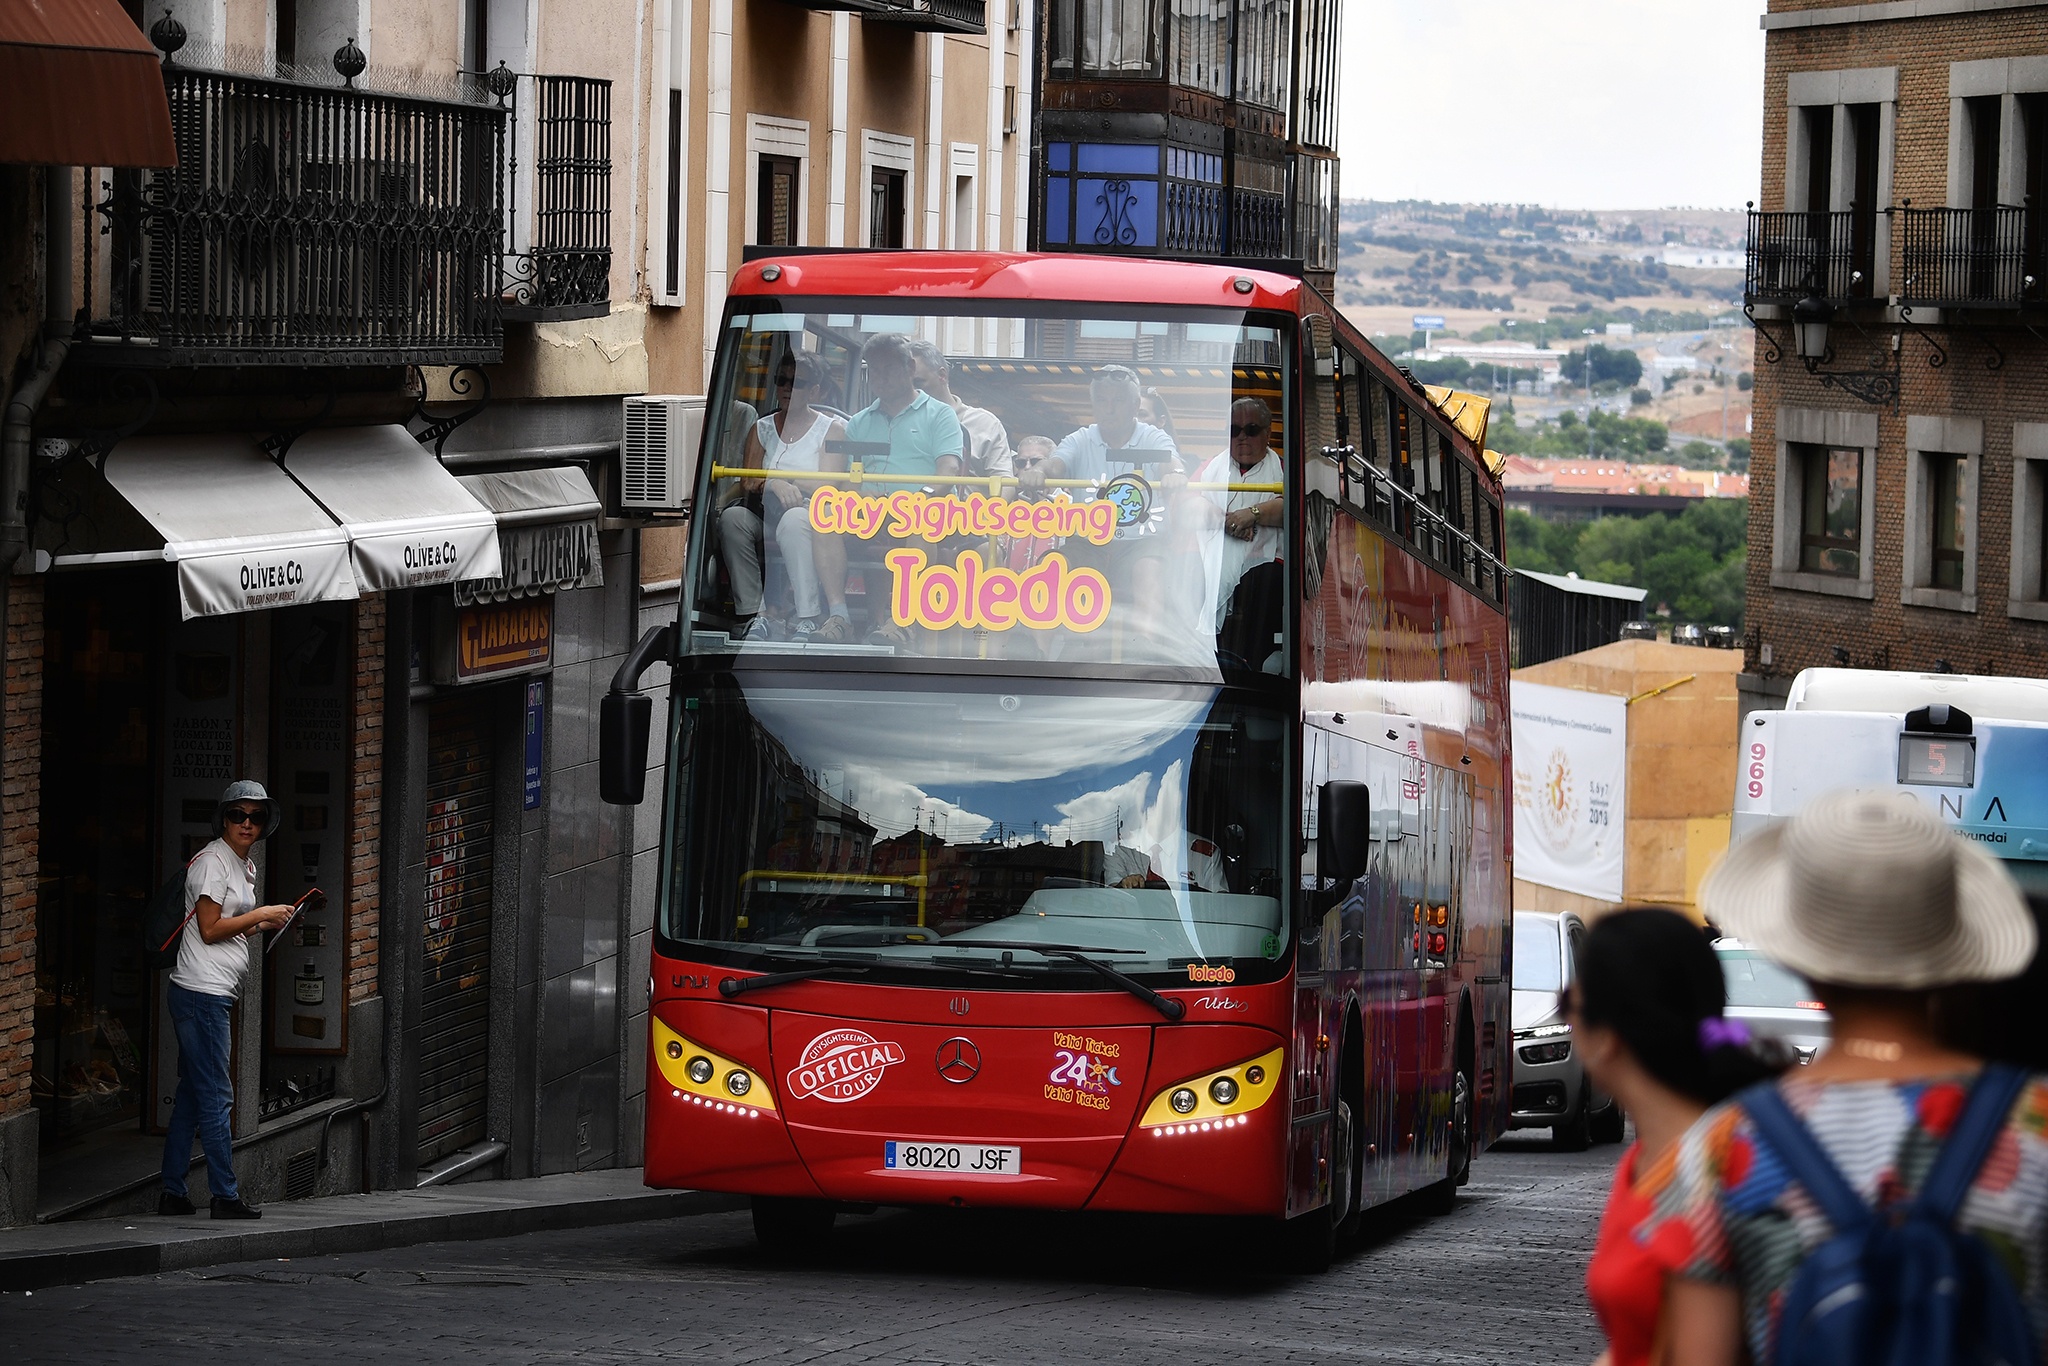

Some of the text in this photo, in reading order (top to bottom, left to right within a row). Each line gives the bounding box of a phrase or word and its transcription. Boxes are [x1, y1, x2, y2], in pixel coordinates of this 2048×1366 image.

[278, 566, 285, 586] &
[246, 591, 296, 605] TOLEDO SOAP MARKET
[885, 548, 1112, 633] Toledo
[481, 605, 549, 650] TABACOS
[173, 716, 232, 730] JABÓN Y
[285, 719, 341, 728] COSMETICS
[319, 710, 341, 718] AND
[173, 740, 232, 751] LOCAL DE
[173, 753, 232, 767] ACEITE
[1748, 743, 1766, 798] 969
[1928, 743, 1946, 775] 5
[173, 767, 232, 778] DE OLIVA
[1187, 964, 1235, 983] Toledo
[809, 1033, 868, 1060] CITYSIGHTSEEING
[1053, 1031, 1120, 1057] Valid Ticket
[800, 1045, 898, 1090] OFFICIAL
[1050, 1050, 1087, 1087] 24
[833, 1072, 877, 1097] TOUR
[1044, 1084, 1110, 1111] Valid Ticket
[905, 1146, 960, 1168] 8020
[970, 1149, 1012, 1170] JSF
